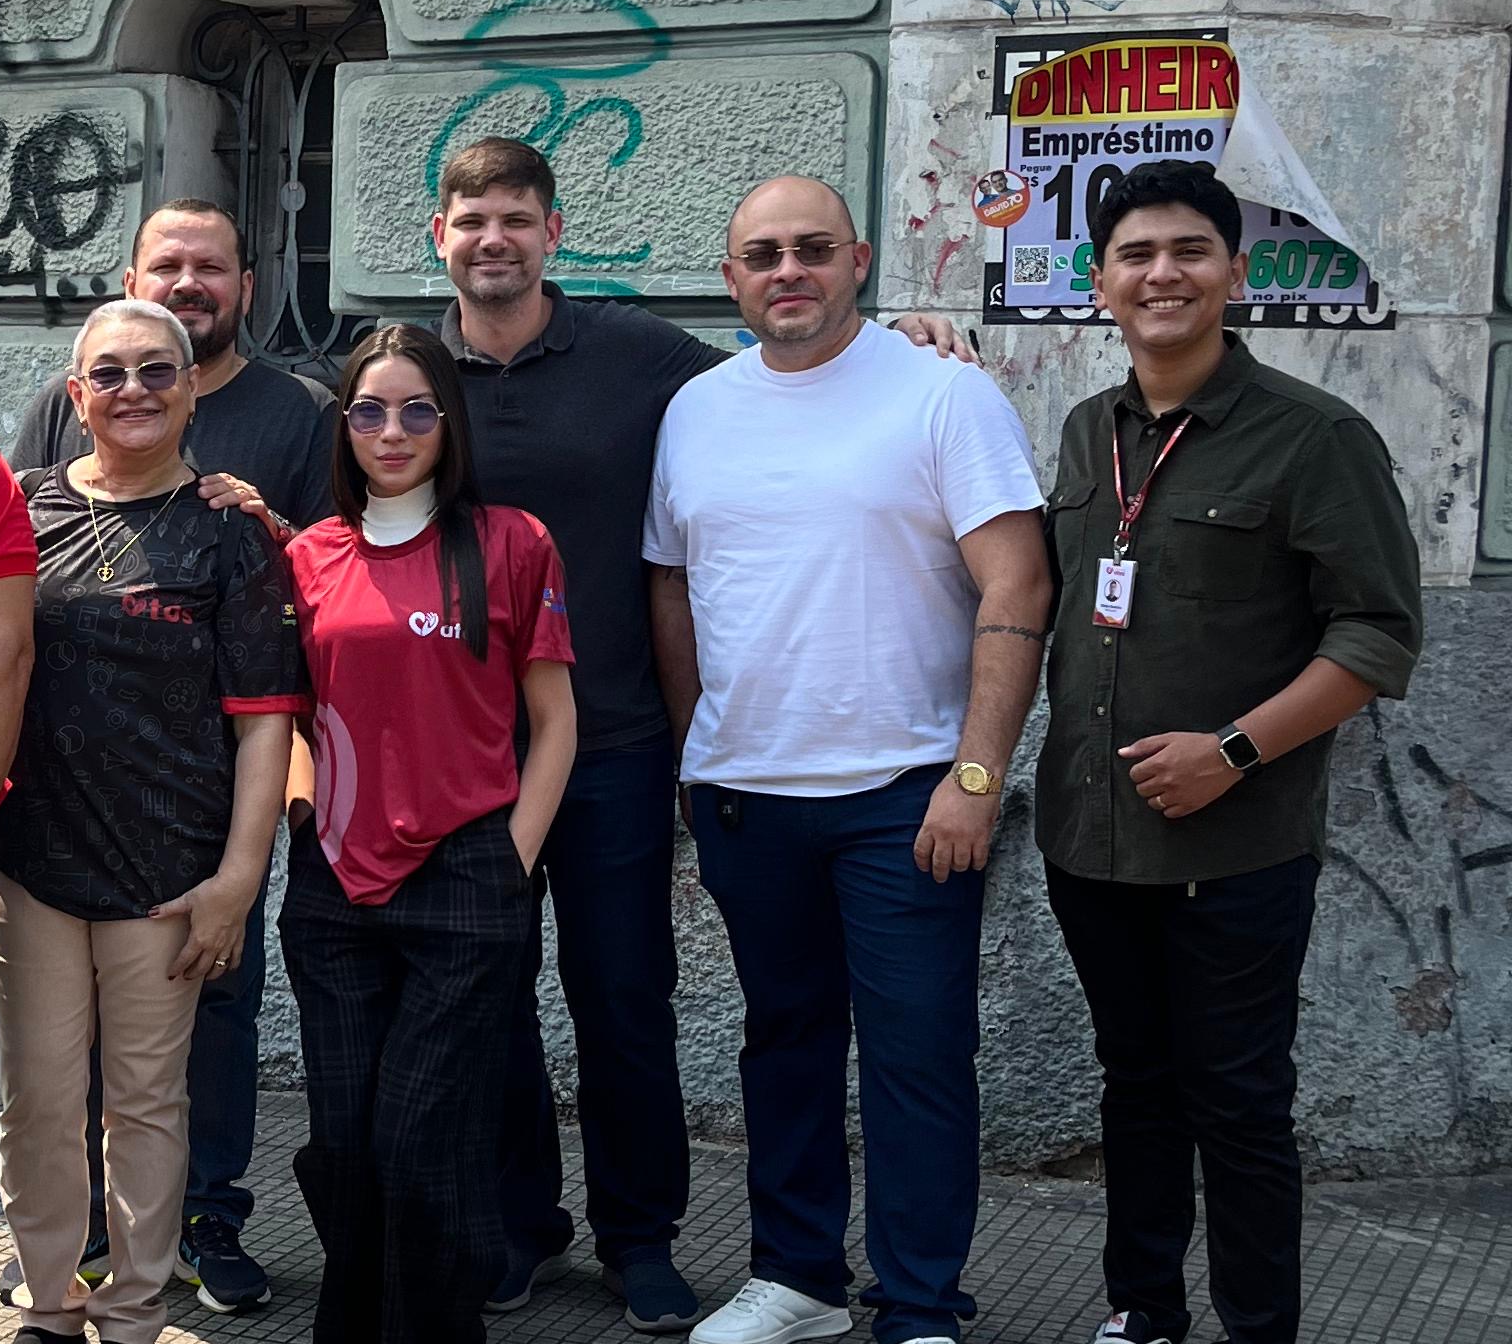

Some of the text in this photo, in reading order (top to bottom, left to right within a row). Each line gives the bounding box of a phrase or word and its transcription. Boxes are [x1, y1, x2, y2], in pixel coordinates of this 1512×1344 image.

[1017, 46, 1240, 117] DINHEIR
[1022, 123, 1214, 163] Empréstimo
[1020, 164, 1052, 174] Pegue
[1247, 239, 1360, 290] 6073
[1252, 291, 1308, 303] no pix
